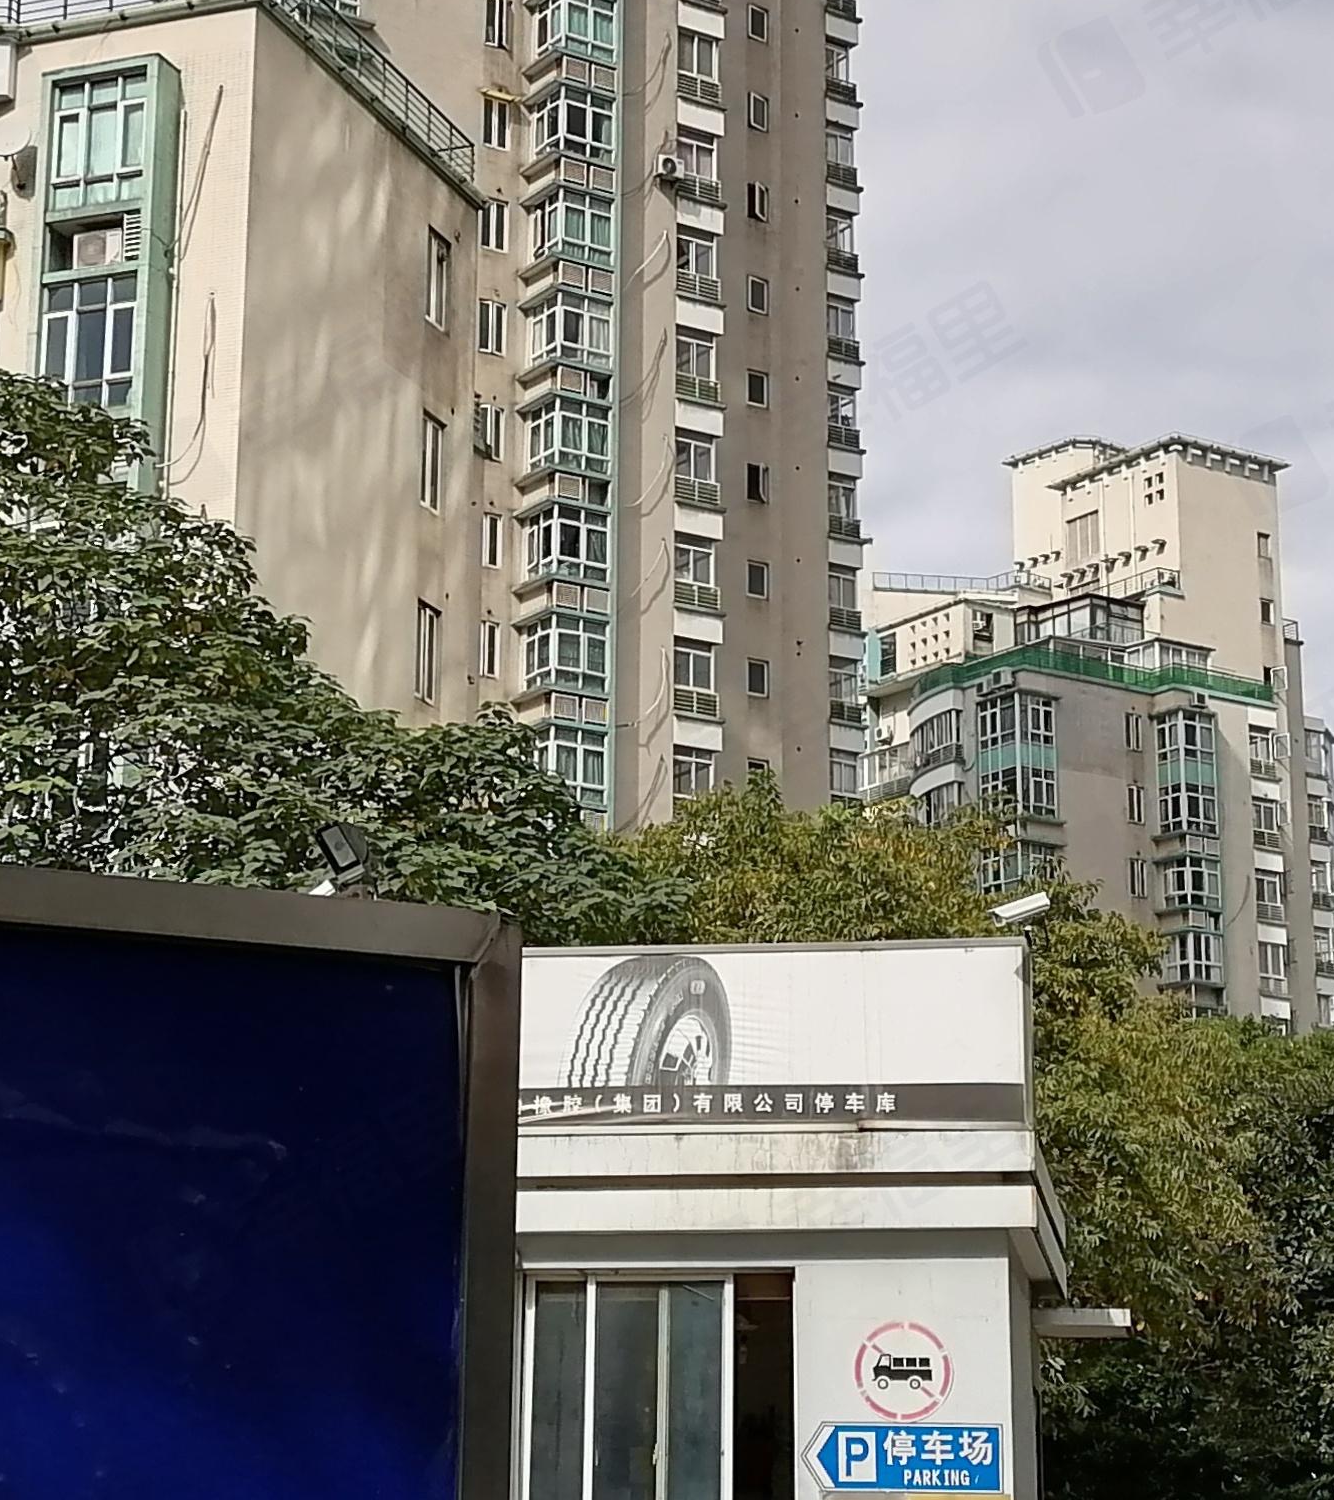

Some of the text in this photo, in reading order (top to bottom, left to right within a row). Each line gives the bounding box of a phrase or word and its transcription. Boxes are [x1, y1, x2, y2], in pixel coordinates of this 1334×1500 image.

[519, 1090, 898, 1116] 橡胶（集团）有限公司停车库
[883, 1429, 994, 1466] 停车场
[903, 1468, 971, 1487] PARKING
